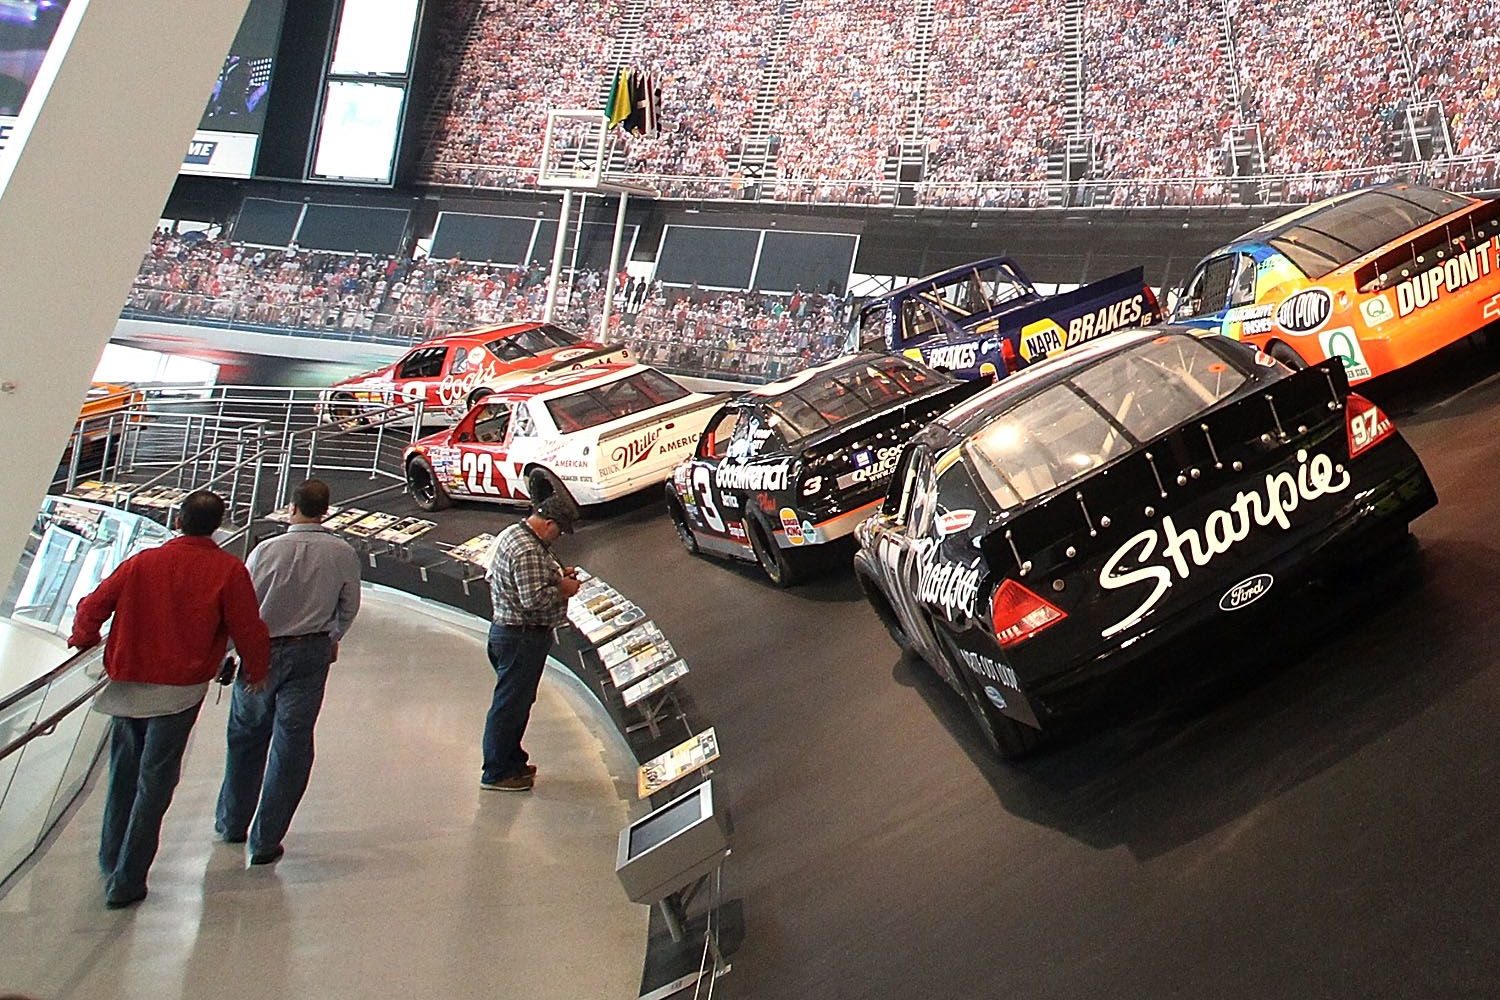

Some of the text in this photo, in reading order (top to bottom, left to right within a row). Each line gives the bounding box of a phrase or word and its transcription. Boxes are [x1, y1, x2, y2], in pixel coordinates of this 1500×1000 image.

[1396, 241, 1492, 318] DUPONT
[1067, 294, 1143, 347] BRAKES
[1140, 312, 1152, 328] 16
[622, 349, 629, 359] 9
[929, 342, 979, 370] BRAKES
[1026, 329, 1062, 357] NAPA
[1328, 331, 1361, 369] Q
[438, 361, 497, 405] Coors
[1351, 405, 1379, 445] 97
[554, 459, 589, 469] AMERICAN
[612, 425, 663, 470] Miller
[462, 452, 501, 495] 22
[599, 464, 620, 477] BUICK
[803, 476, 822, 496] 3
[693, 466, 726, 533] 3
[786, 526, 802, 537] KING
[1099, 449, 1351, 638] Sharpie
[913, 536, 981, 622] Sharpie
[1230, 578, 1264, 606] Ford
